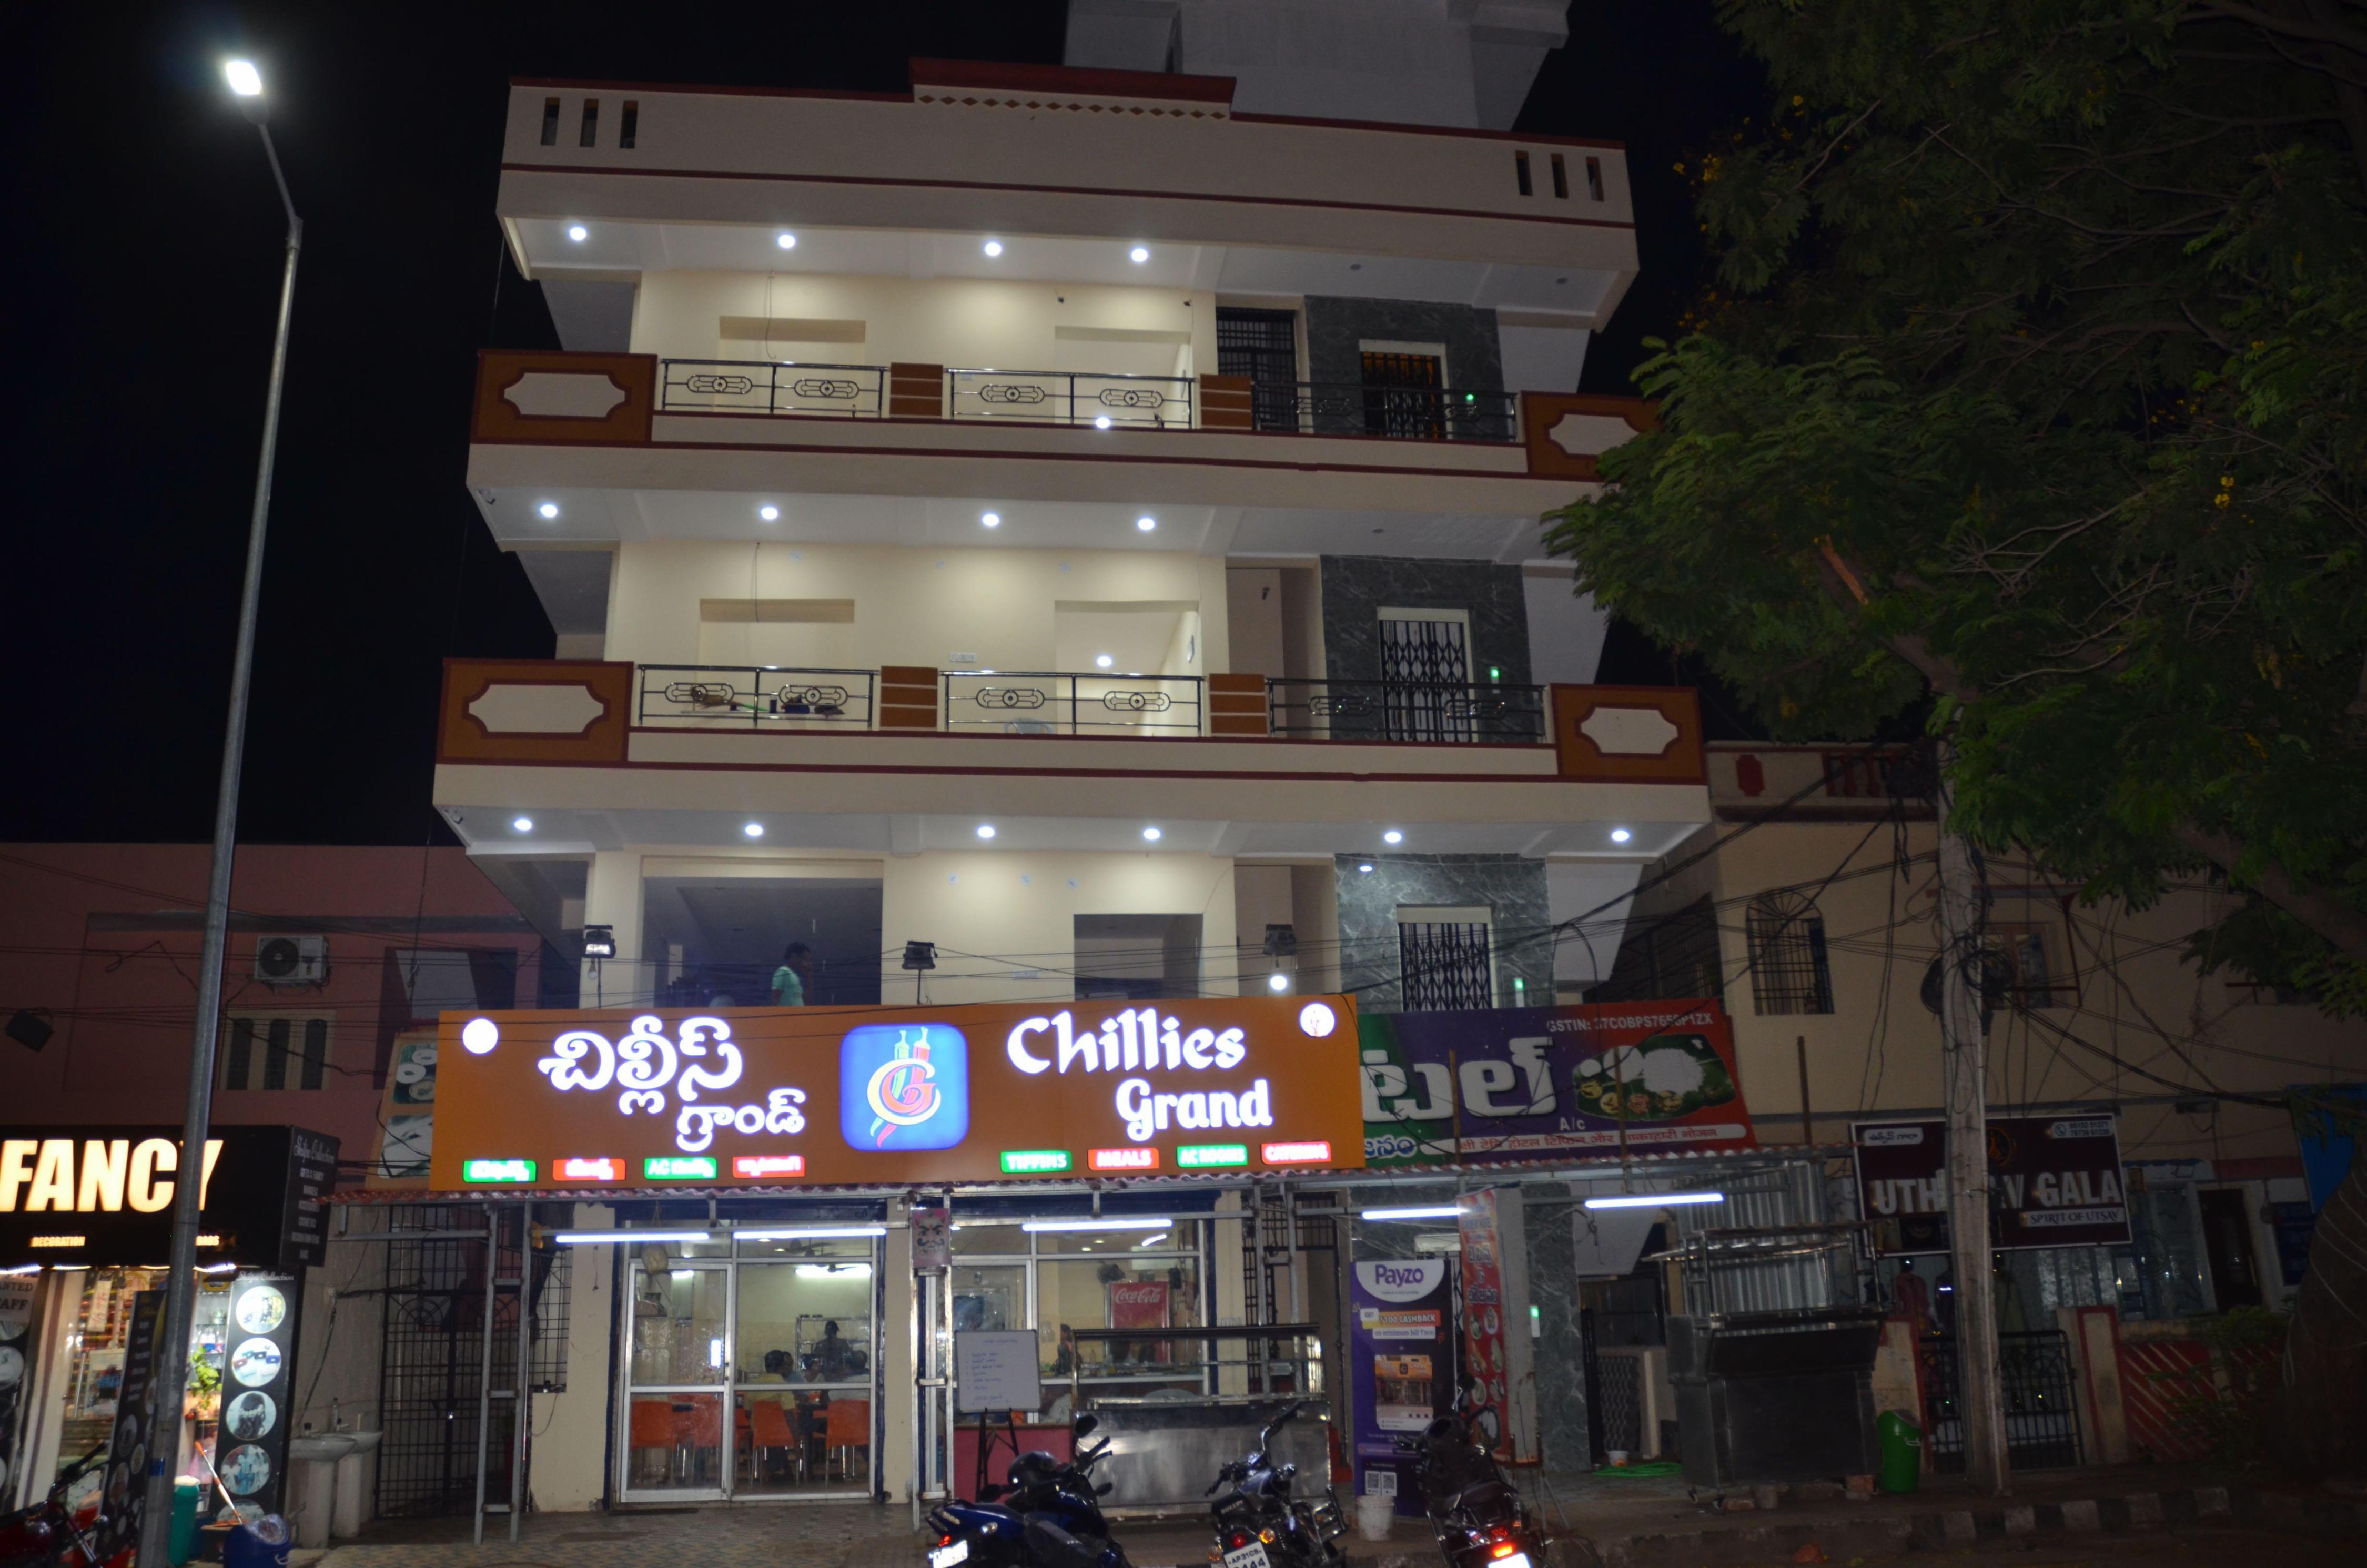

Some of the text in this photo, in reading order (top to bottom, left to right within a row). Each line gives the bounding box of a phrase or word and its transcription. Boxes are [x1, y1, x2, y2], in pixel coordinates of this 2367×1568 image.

[1546, 1018, 1592, 1033] GSTIN:
[1007, 1007, 1246, 1075] Chillies
[537, 1015, 744, 1115] చిల్లీస్
[1116, 1078, 1273, 1142] Grand
[676, 1088, 806, 1152] గ్రాండ్
[1625, 1128, 1677, 1142] ाकाहारी
[1006, 1152, 1067, 1170] TIFFINS
[1097, 1149, 1151, 1167] MEALS
[1181, 1150, 1198, 1164] AC
[2038, 1169, 2122, 1208] GALA
[2030, 1211, 2065, 1225] SPIRIT
[2067, 1211, 2085, 1222] OF
[30, 1236, 85, 1247] DECORATION
[1374, 1264, 1424, 1288] Payzo
[1115, 1287, 1163, 1304] Coca-Cola
[1399, 1313, 1437, 1324] CASHBACK
